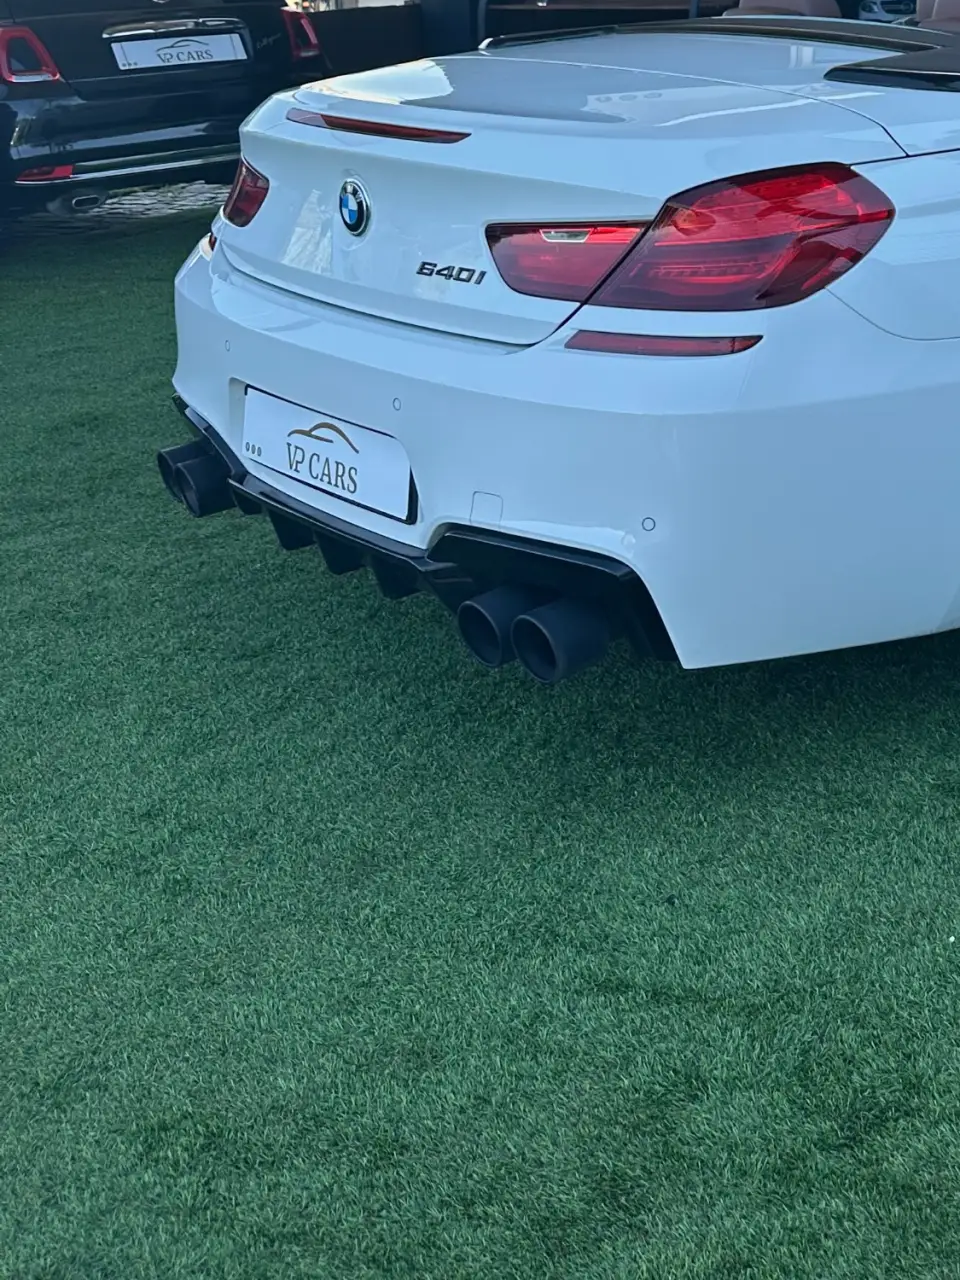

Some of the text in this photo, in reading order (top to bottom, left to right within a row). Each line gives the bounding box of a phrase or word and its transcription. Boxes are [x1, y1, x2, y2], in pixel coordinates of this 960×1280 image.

[157, 49, 213, 63] VP CARS
[286, 441, 358, 494] VP CARS
